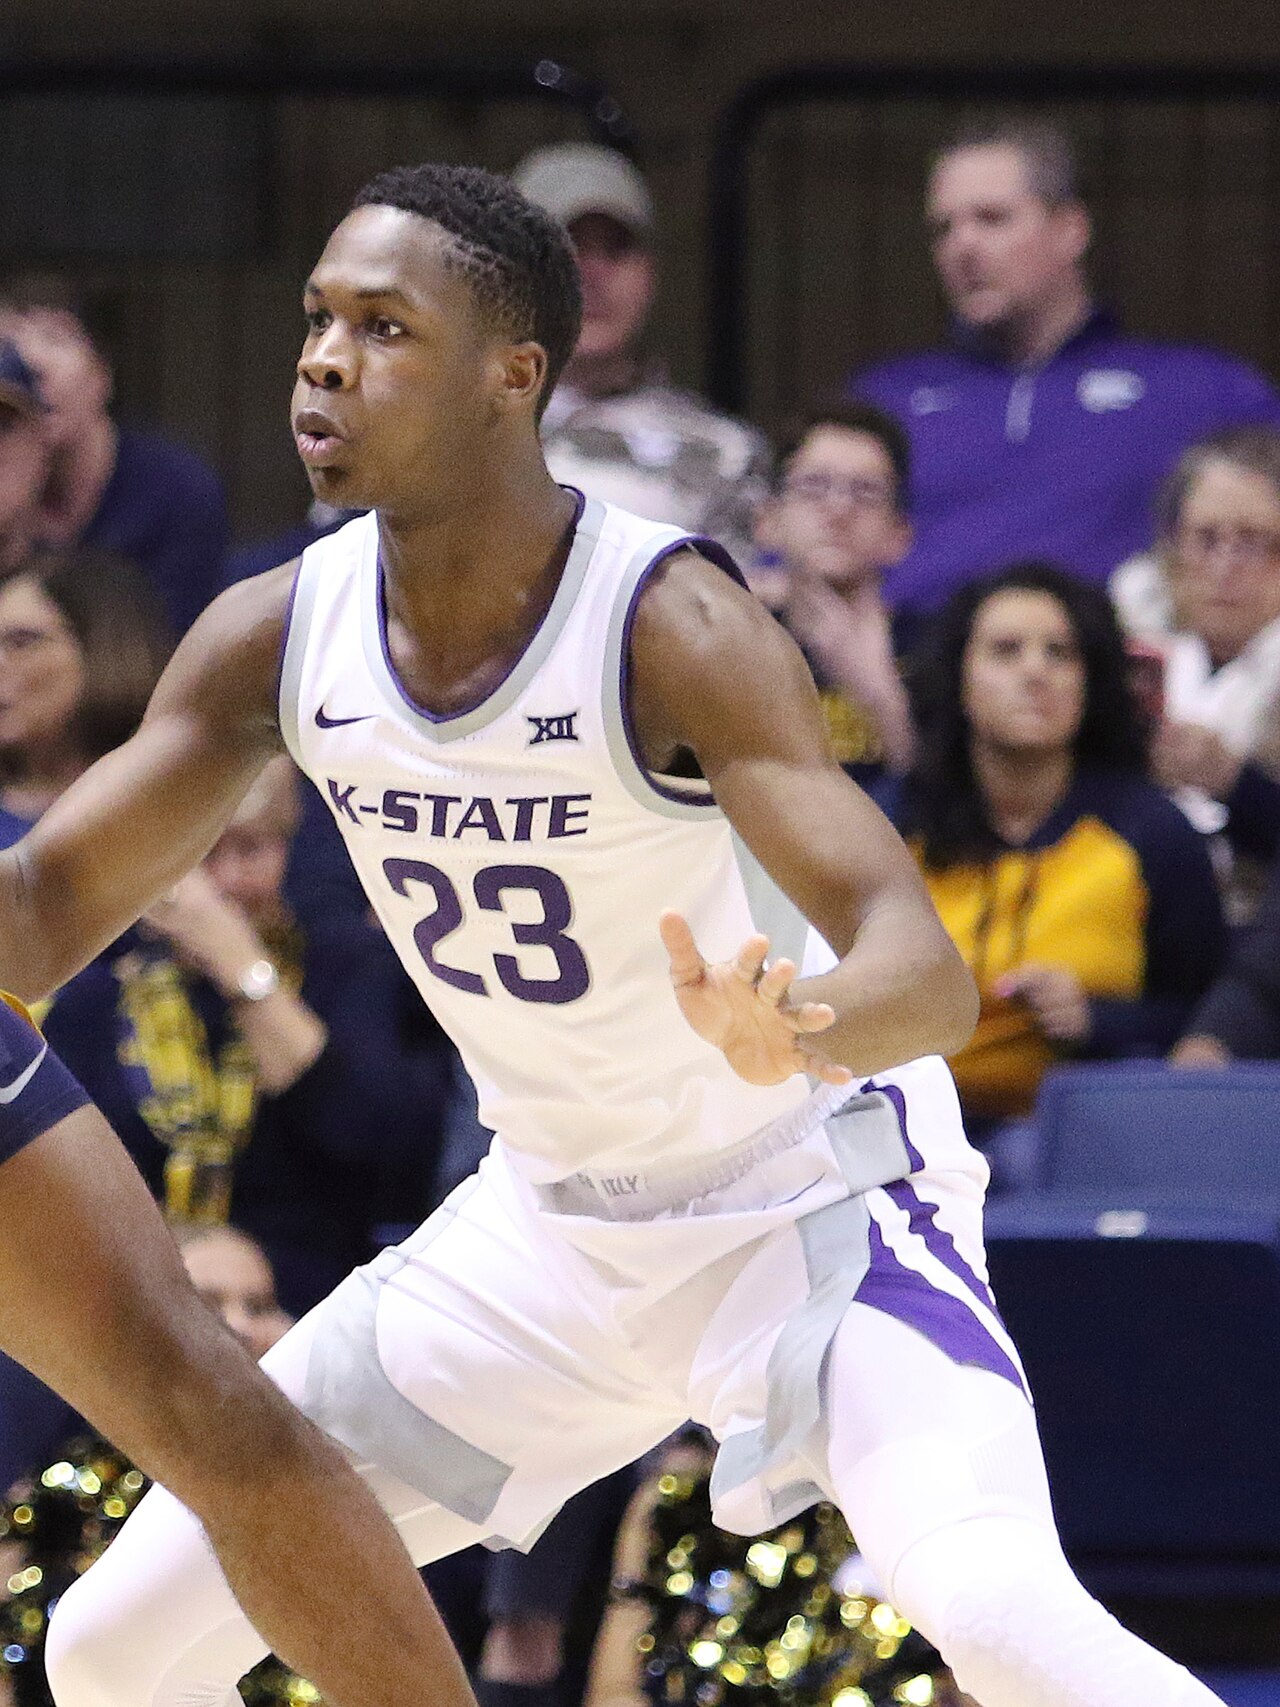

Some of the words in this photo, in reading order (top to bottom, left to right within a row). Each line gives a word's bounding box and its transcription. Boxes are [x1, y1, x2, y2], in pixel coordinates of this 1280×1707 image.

[527, 711, 579, 744] XII
[326, 778, 592, 842] K-STATE
[382, 857, 591, 1004] 23
